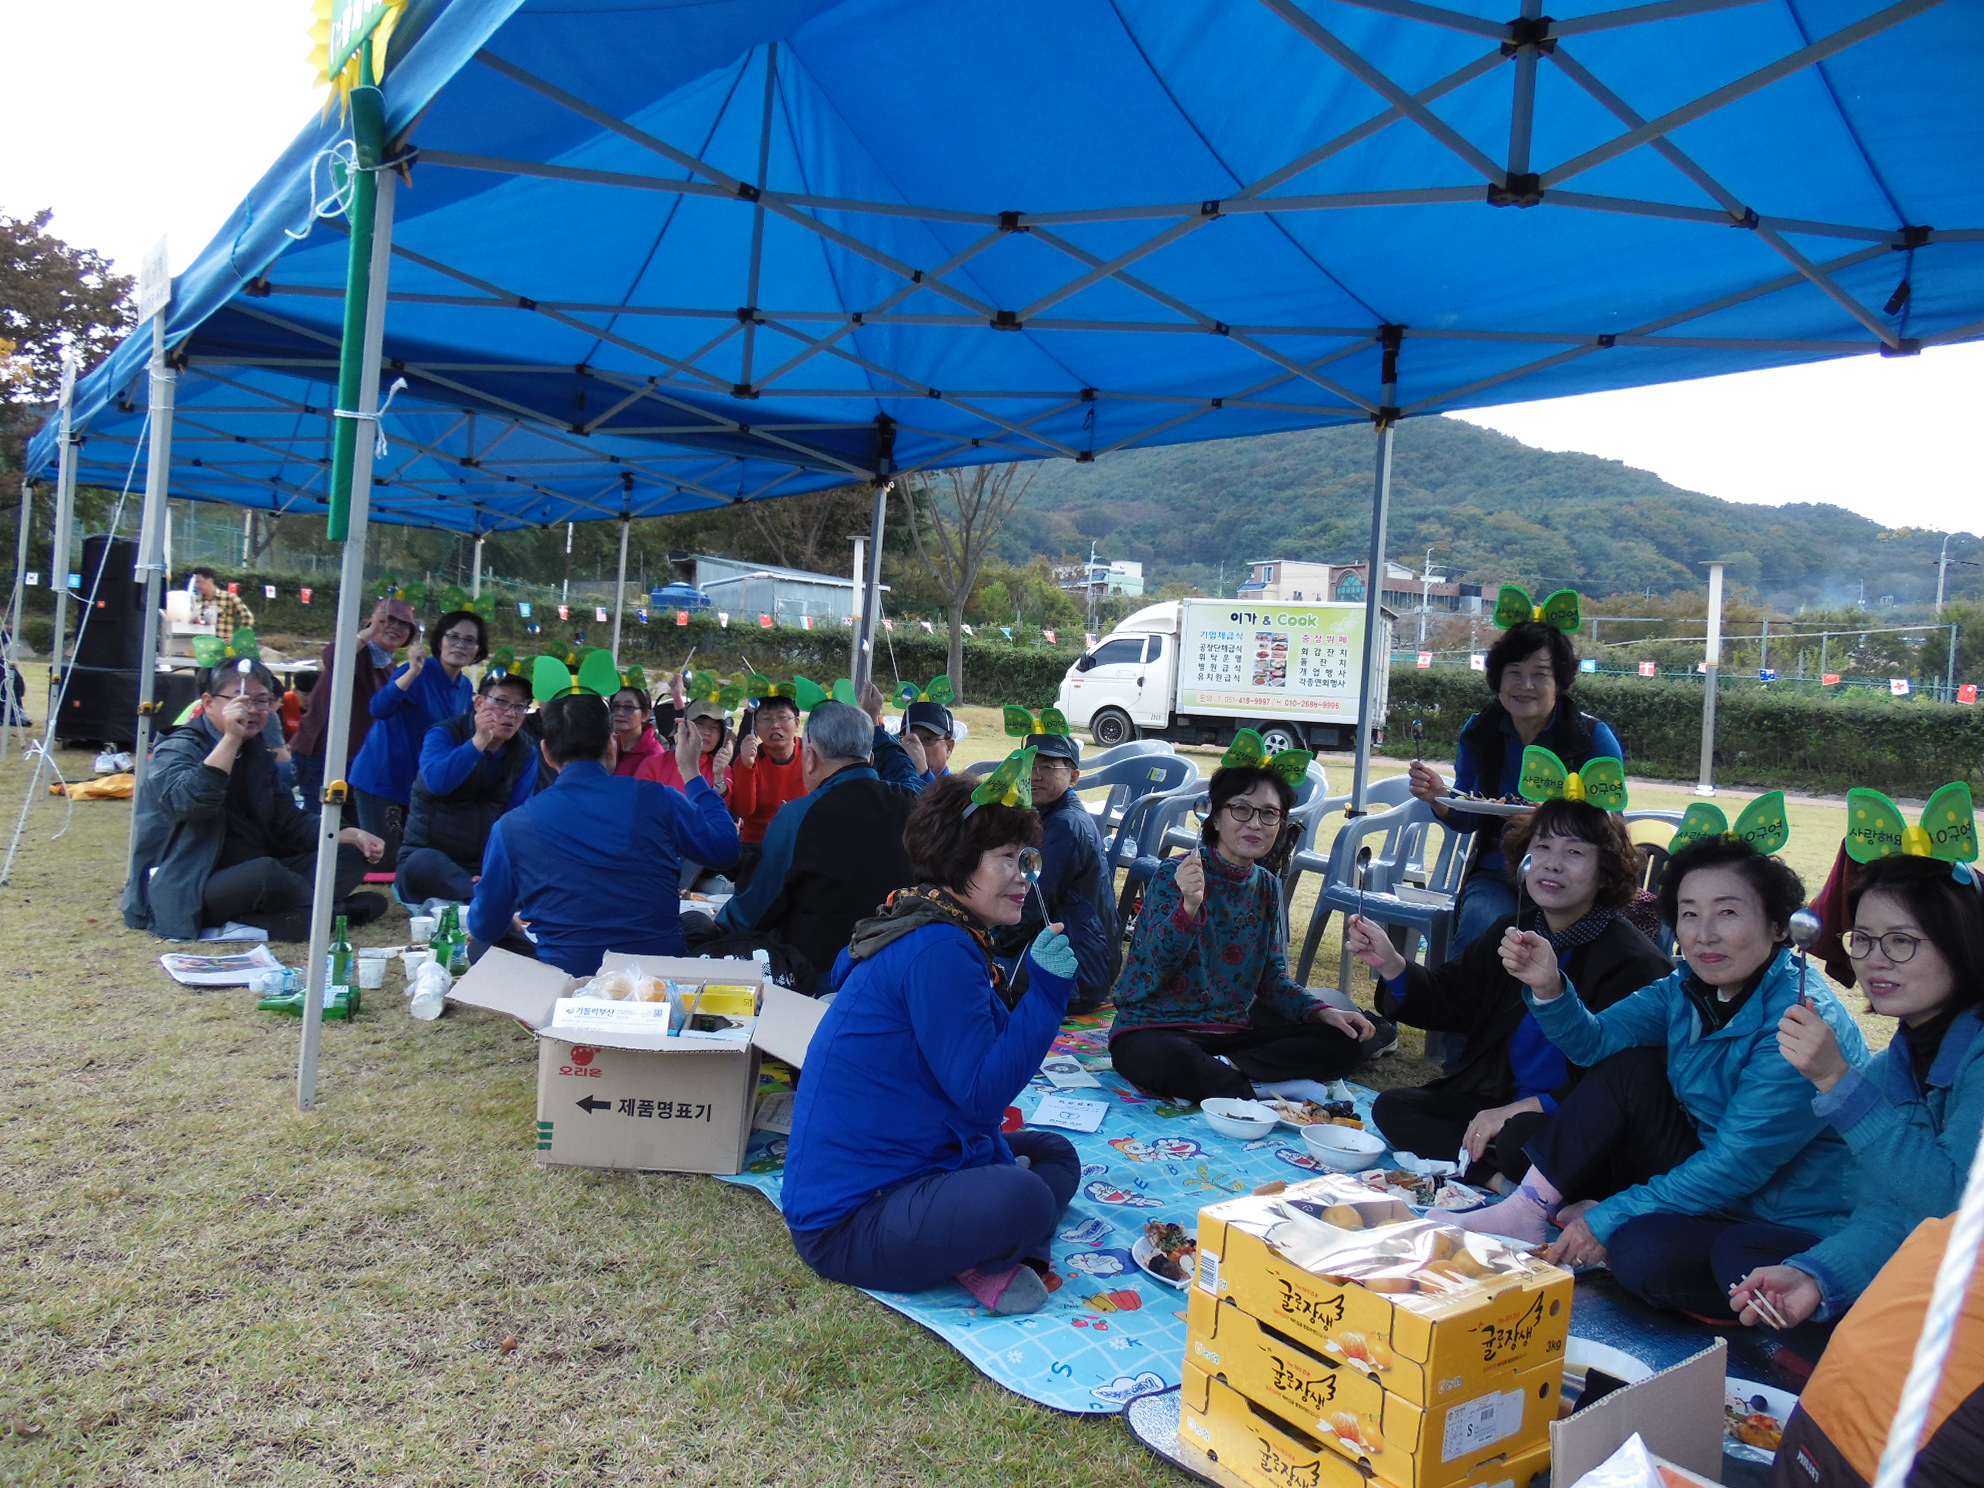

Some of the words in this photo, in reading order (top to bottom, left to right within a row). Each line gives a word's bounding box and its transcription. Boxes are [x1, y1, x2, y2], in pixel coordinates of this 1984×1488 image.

[1230, 612, 1257, 625] 이가
[1262, 616, 1271, 625] &
[1277, 614, 1317, 627] Cook
[1200, 631, 1243, 640] 기업체급식
[1200, 643, 1242, 653] 공장단체급식
[1522, 775, 1564, 789] 사랑해요
[1849, 827, 1902, 845] 사랑해요
[1927, 821, 1972, 844] 10구역
[559, 1066, 602, 1078] 오리온
[618, 1098, 712, 1122] 제품명표기
[1278, 1278, 1345, 1331] 귤로장생
[1480, 1290, 1544, 1361] 귤로장생
[1270, 1354, 1337, 1410] 귤로장생
[1467, 1423, 1473, 1437] S
